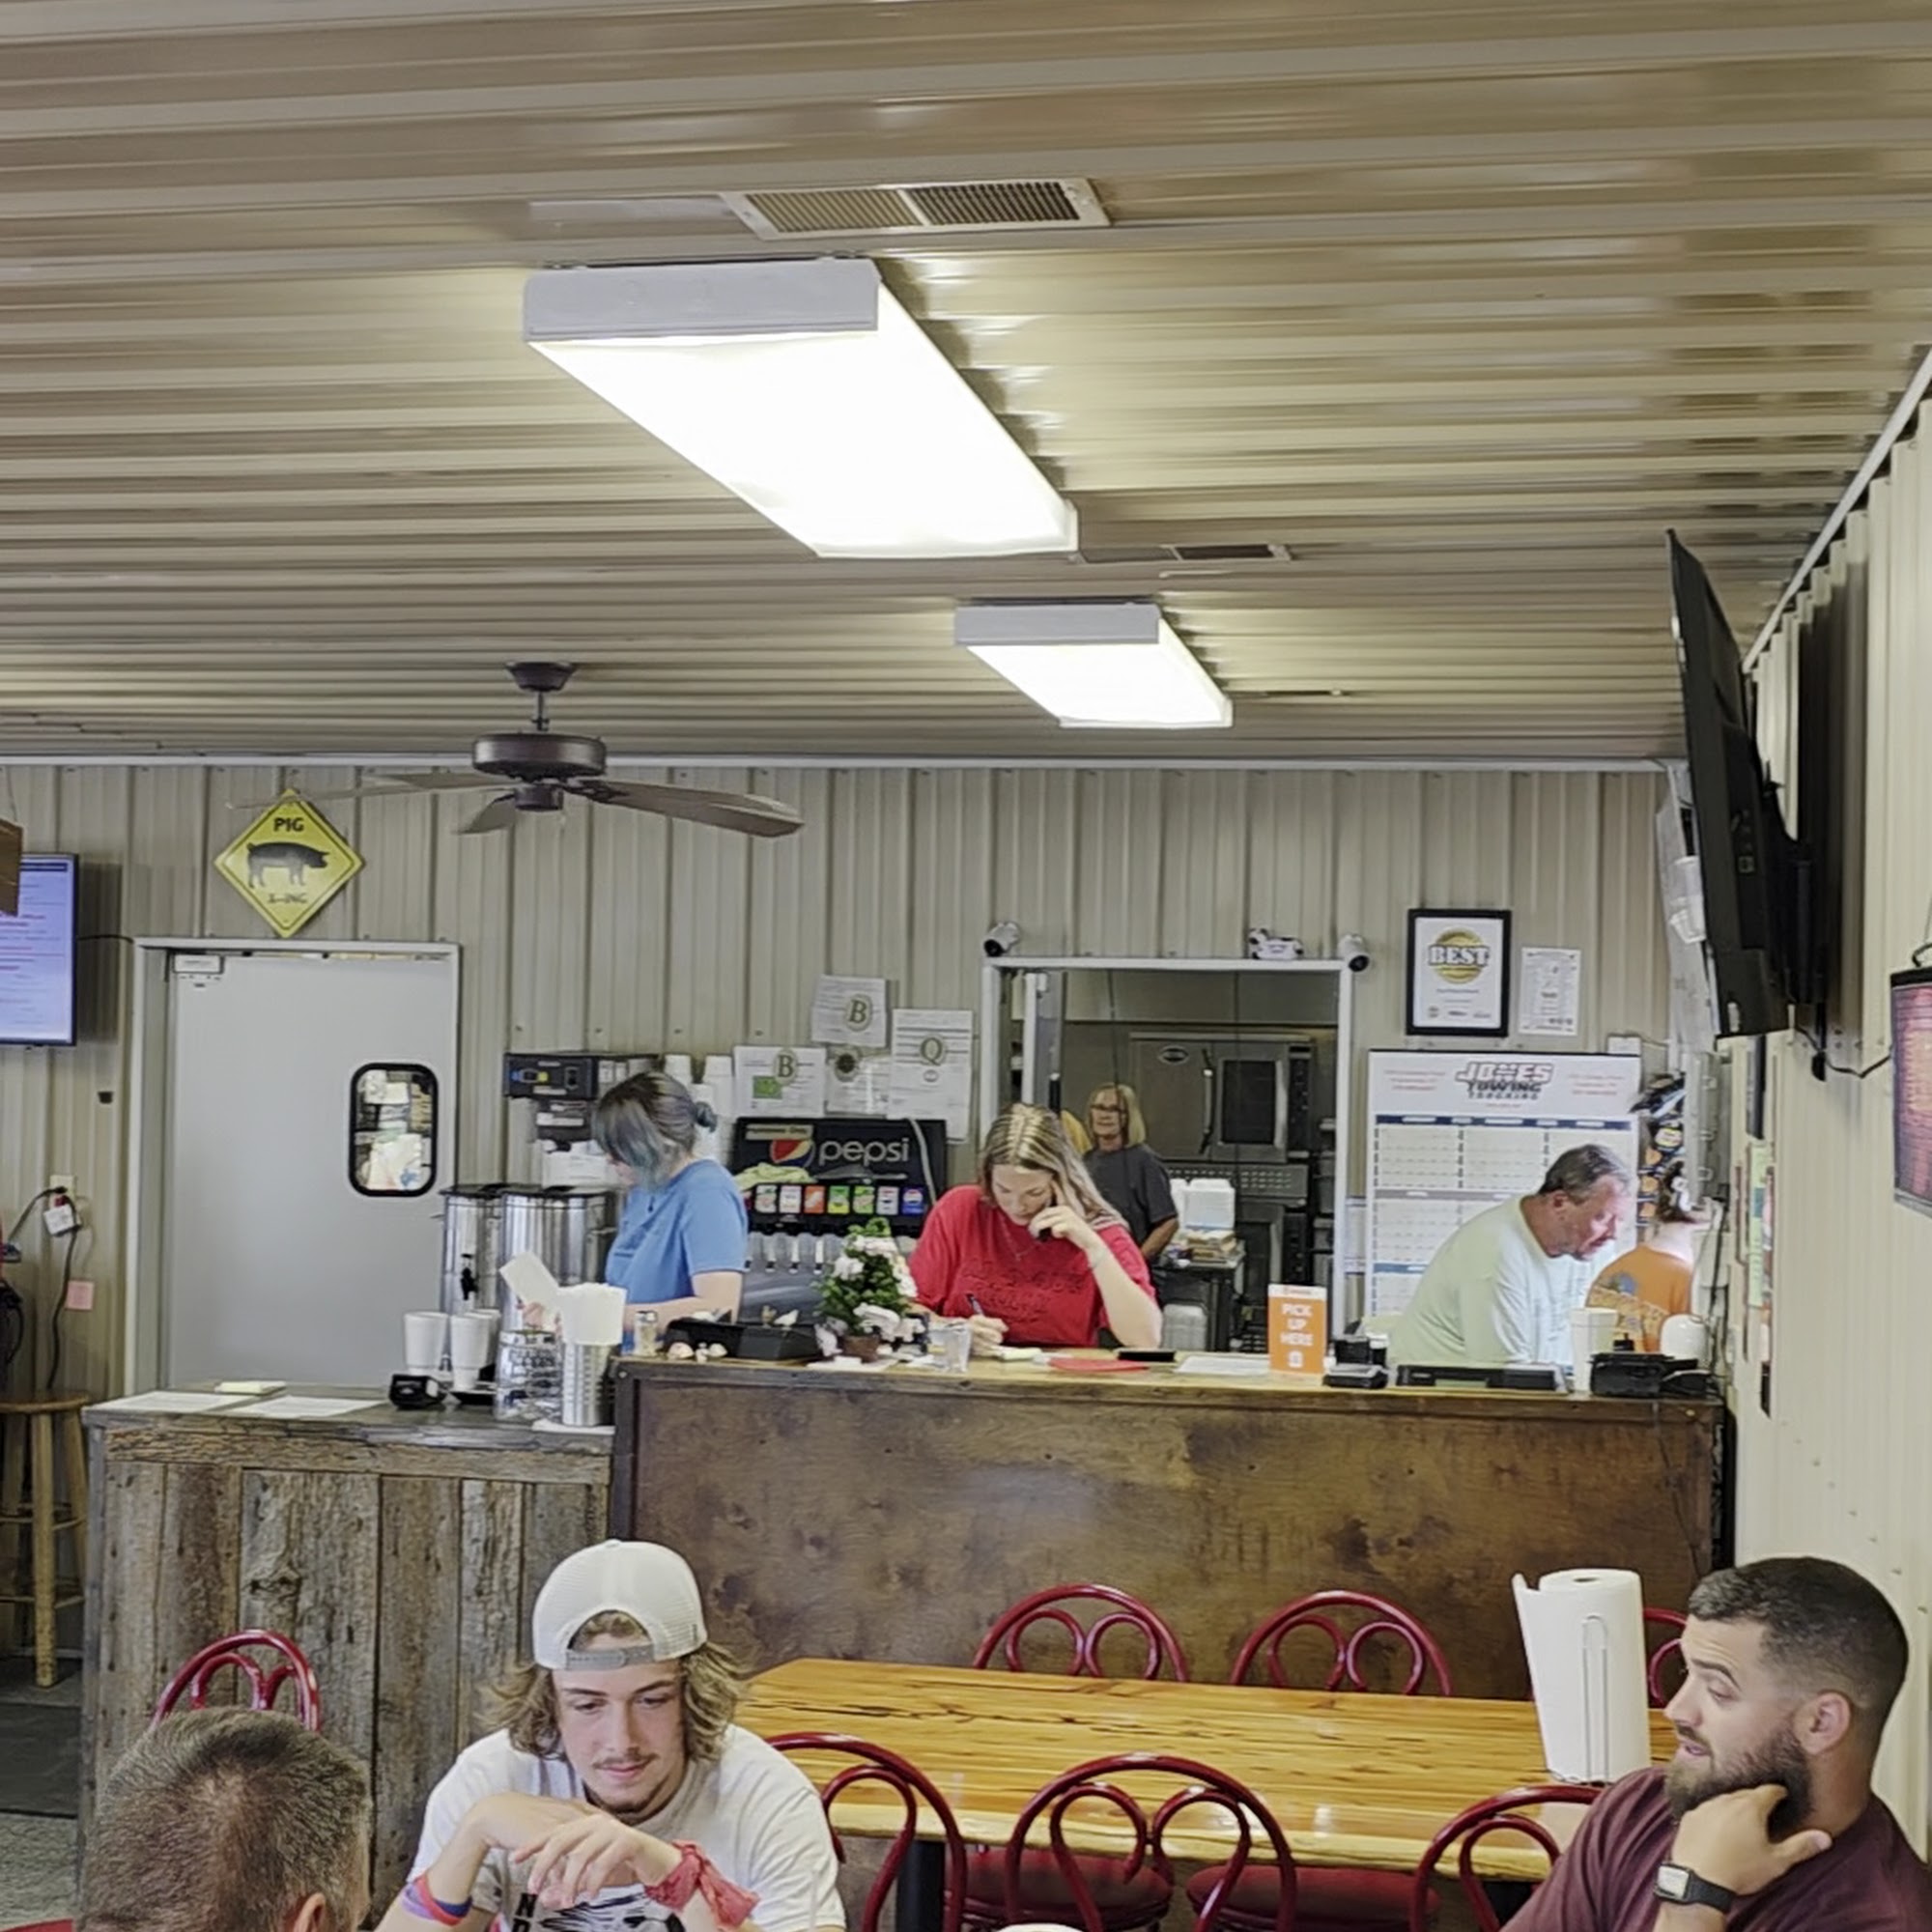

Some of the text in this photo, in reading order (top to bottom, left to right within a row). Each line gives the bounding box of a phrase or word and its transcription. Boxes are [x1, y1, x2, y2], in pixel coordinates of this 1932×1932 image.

[273, 817, 304, 832] PIG
[1428, 943, 1491, 967] BEST
[848, 999, 868, 1024] B
[920, 1037, 943, 1066] Q
[777, 1054, 794, 1078] B
[1467, 1081, 1542, 1093] TOWING
[819, 1137, 910, 1167] pepsi
[1280, 1302, 1313, 1318] PICK
